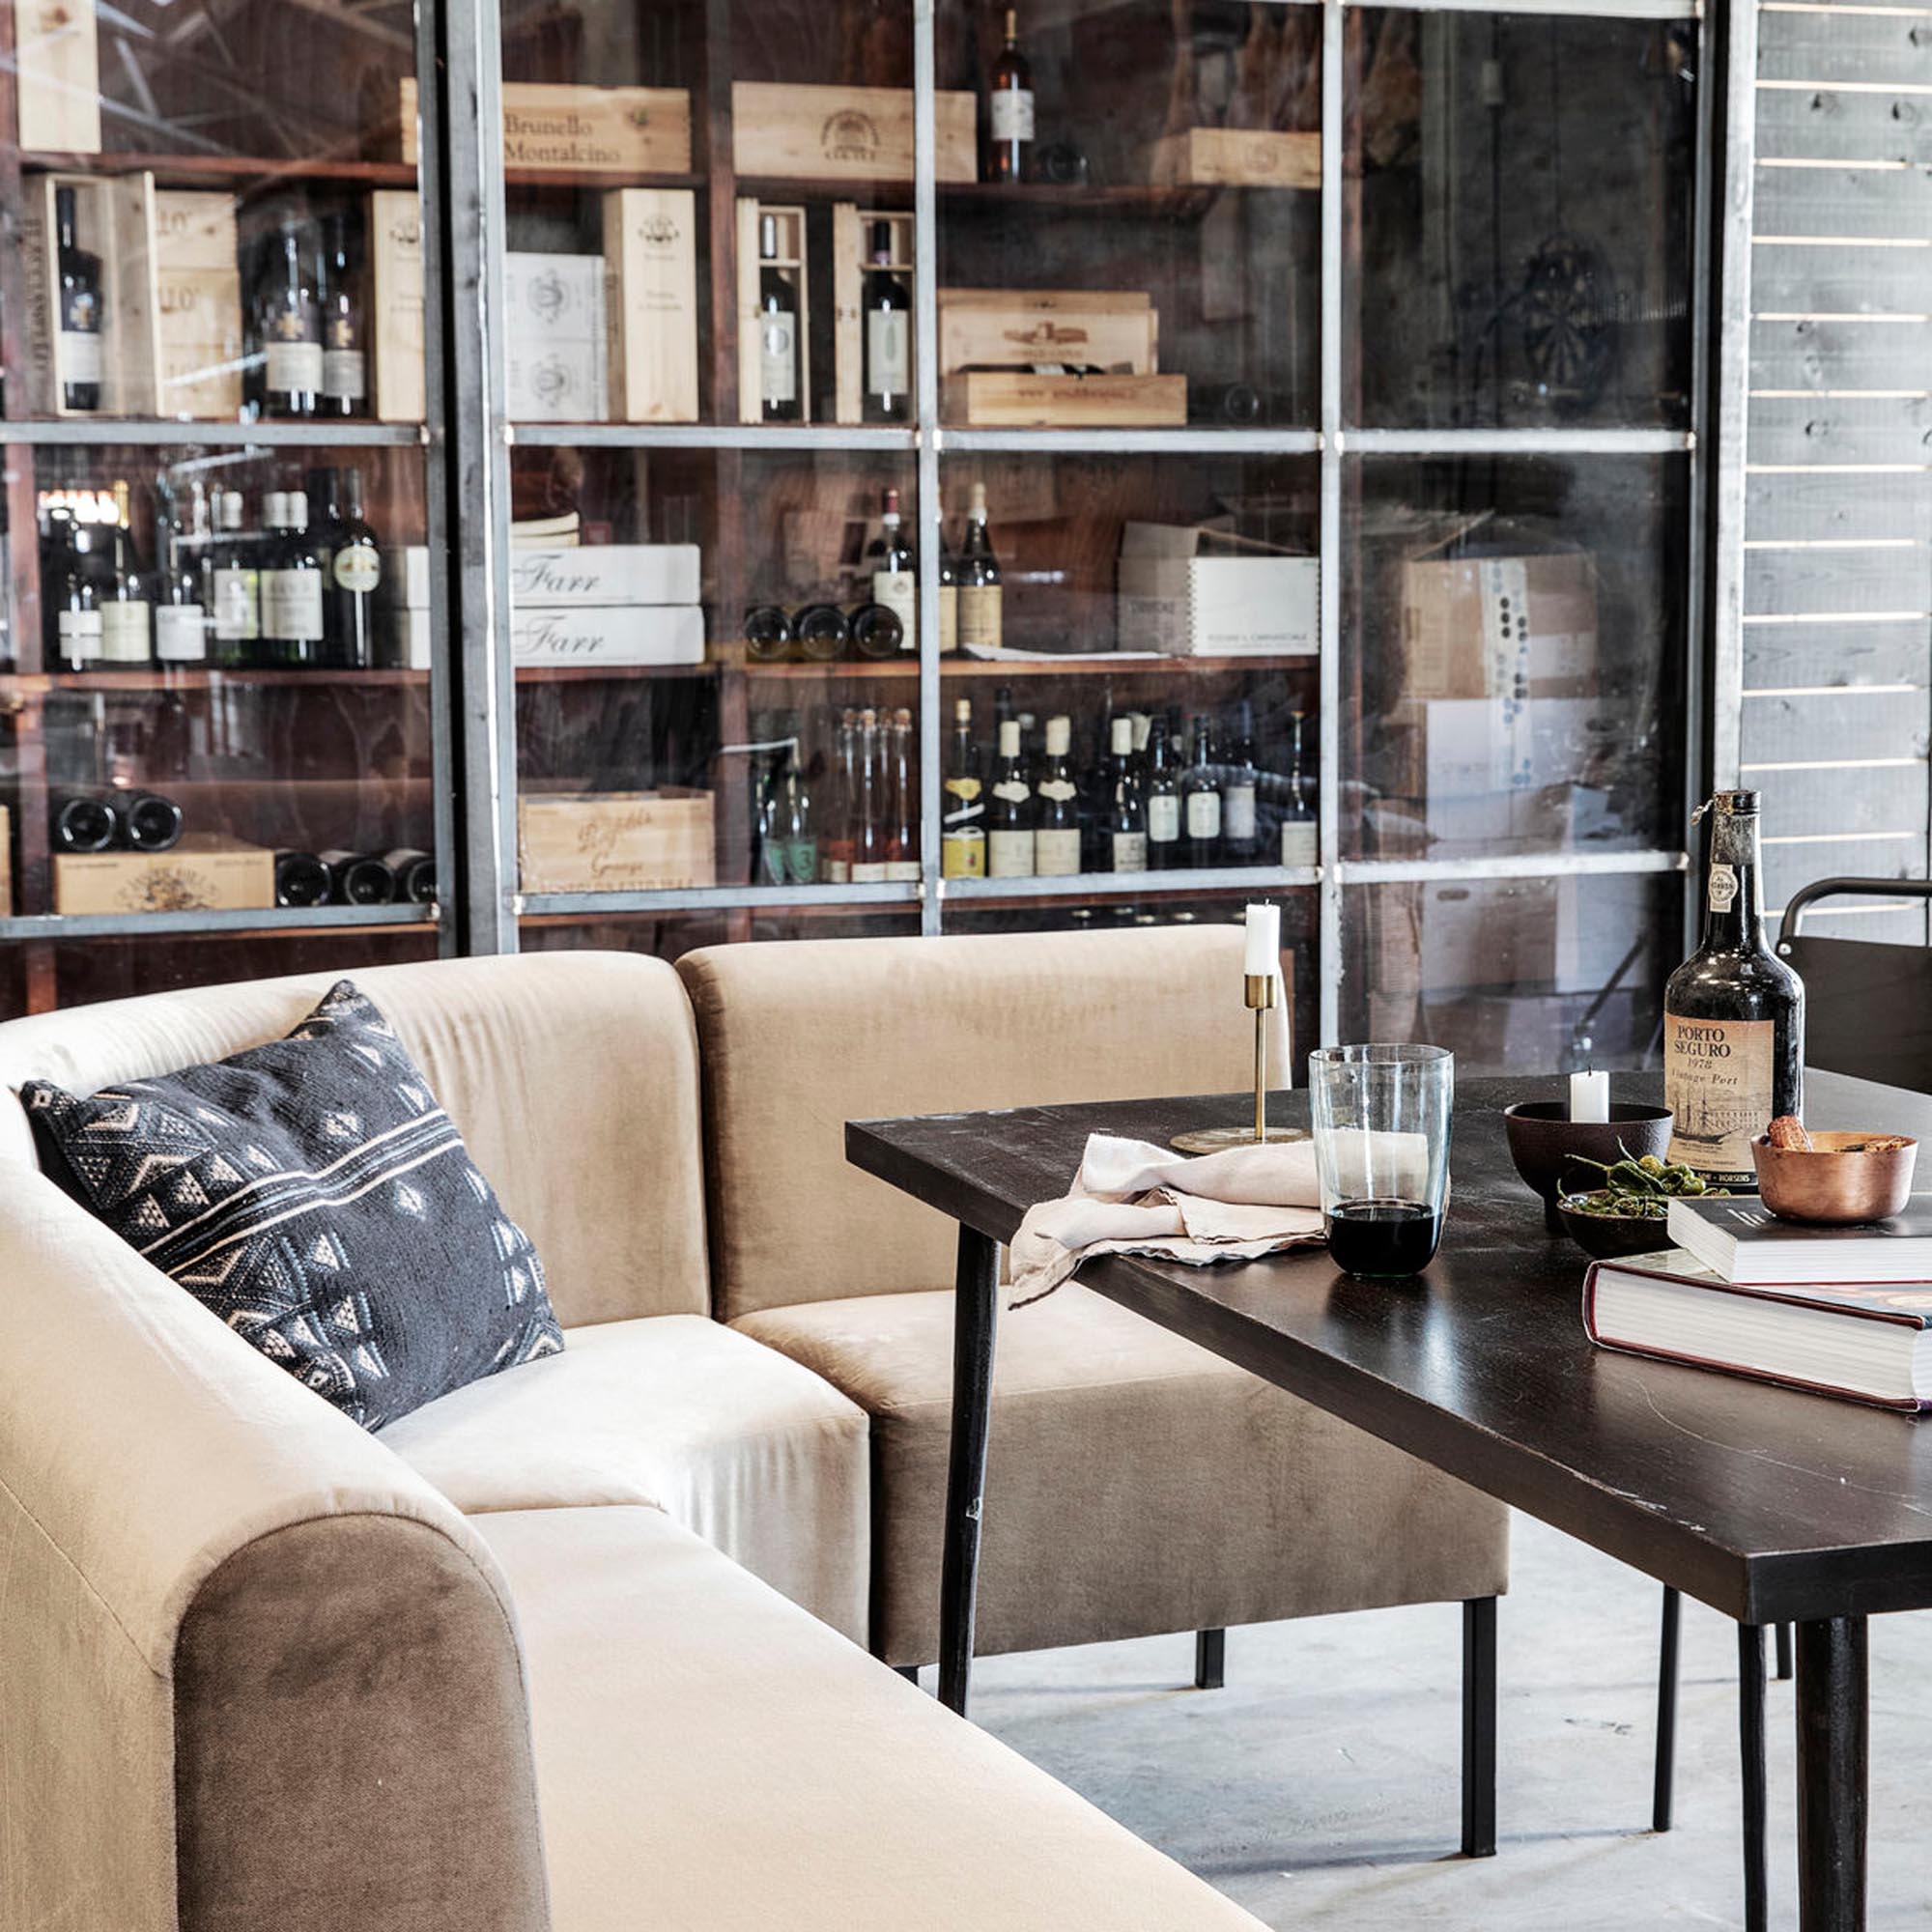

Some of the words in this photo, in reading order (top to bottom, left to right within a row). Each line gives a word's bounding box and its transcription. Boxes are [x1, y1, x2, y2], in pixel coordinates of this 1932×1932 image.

[504, 113, 593, 136] Brunello
[504, 140, 621, 162] Montalcino
[512, 554, 600, 592] Farr
[513, 614, 605, 654] Farr
[1677, 1025, 1725, 1042] PORTO
[1674, 1040, 1731, 1058] SEGURO
[1687, 1058, 1713, 1069] 1978
[1712, 1073, 1738, 1085] Port
